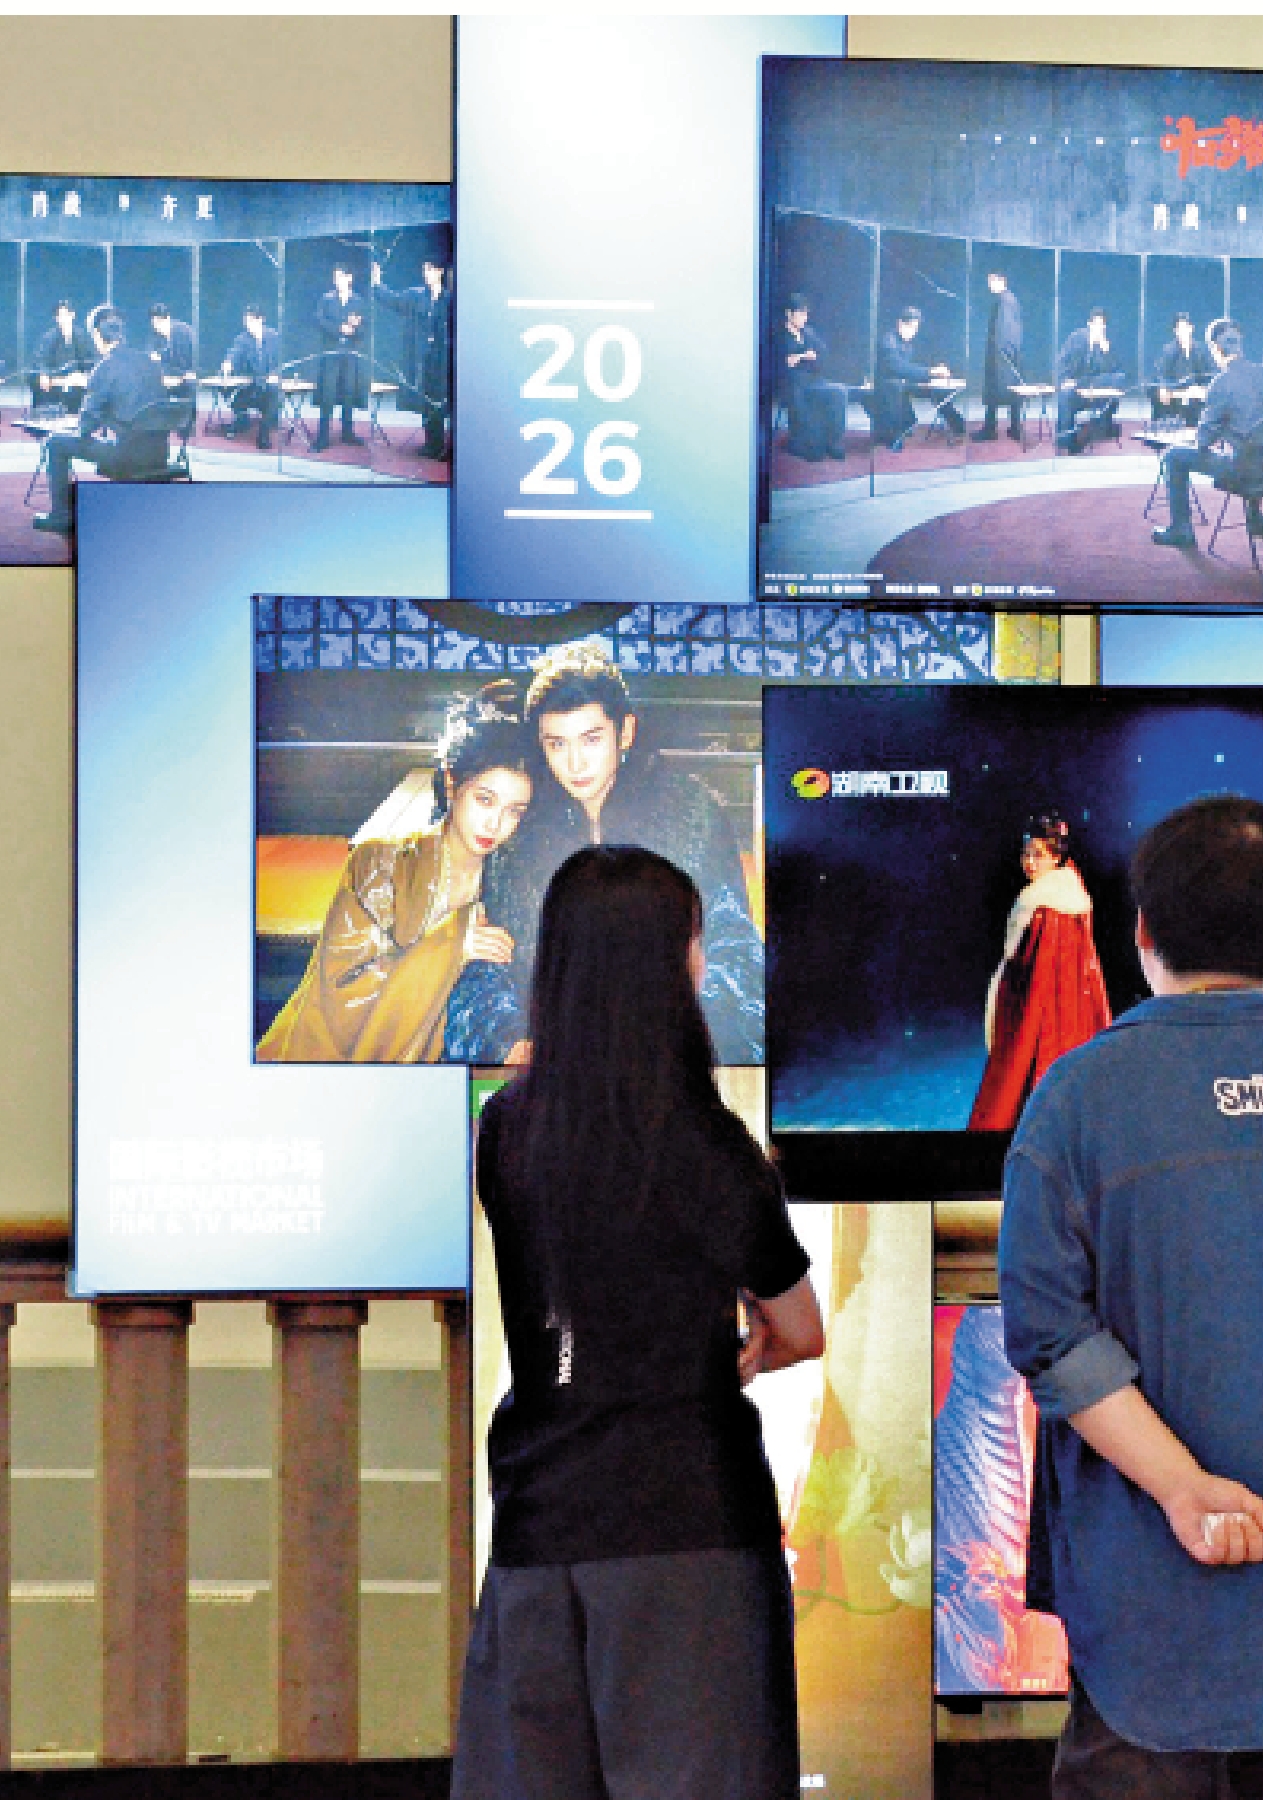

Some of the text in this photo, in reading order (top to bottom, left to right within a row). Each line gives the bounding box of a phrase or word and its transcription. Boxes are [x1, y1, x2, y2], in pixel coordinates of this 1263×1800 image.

[519, 324, 643, 403] 20
[519, 419, 643, 497] 26
[831, 769, 950, 798] 湖南卫视
[192, 1211, 222, 1236] TV
